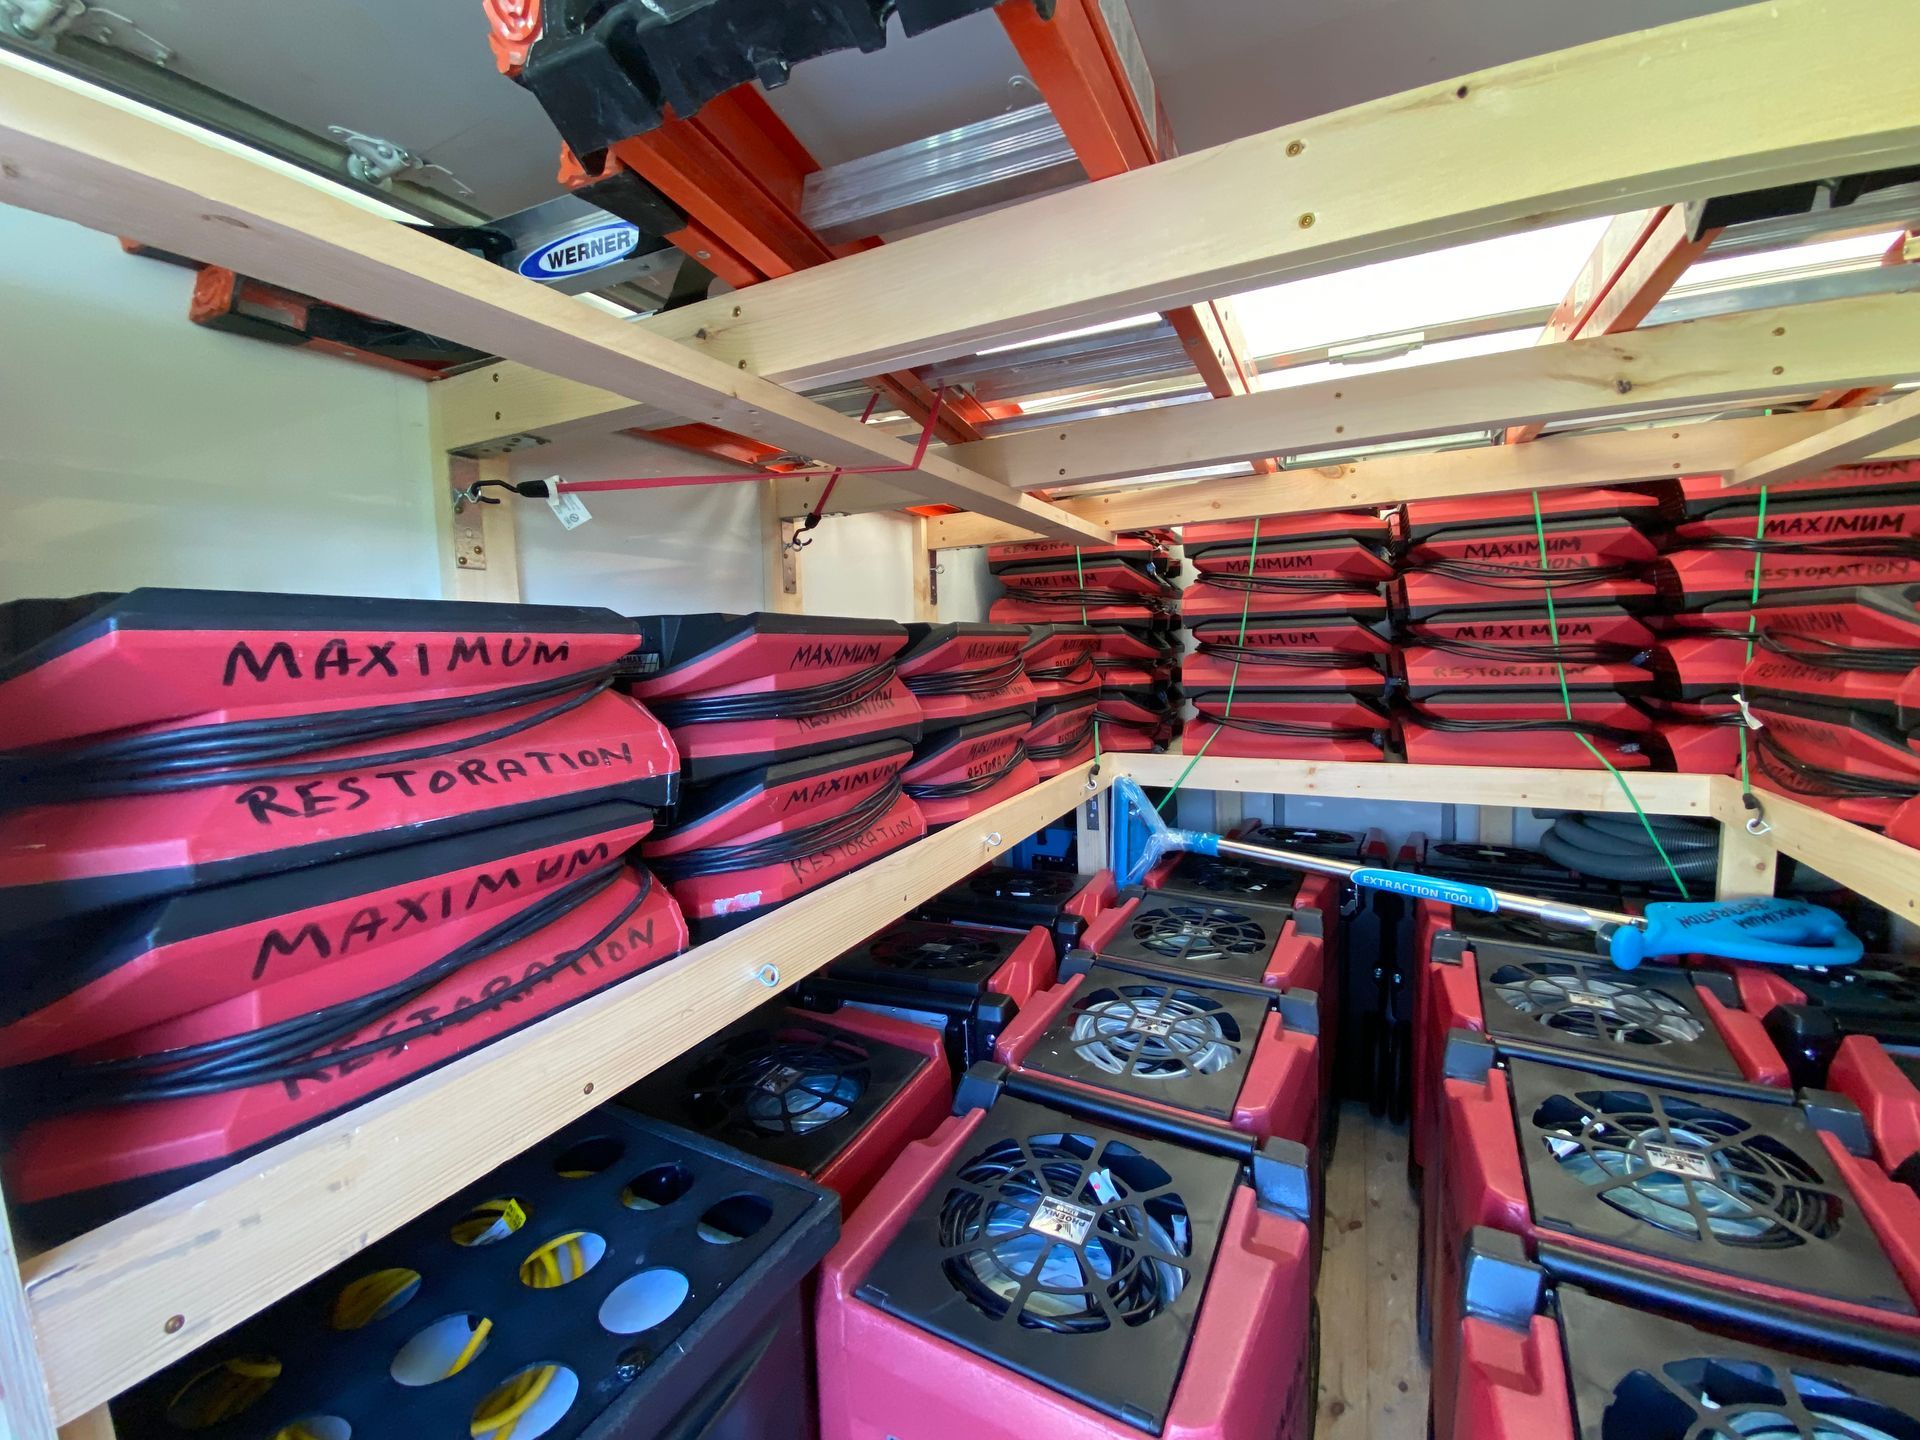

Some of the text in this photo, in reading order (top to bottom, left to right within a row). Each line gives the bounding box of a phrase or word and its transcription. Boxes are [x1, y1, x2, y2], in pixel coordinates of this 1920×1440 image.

[547, 230, 631, 269] WERNER
[1764, 512, 1905, 536] MAXIMUM
[1465, 536, 1582, 559] MAXIMUM
[1455, 622, 1593, 639] MAXIMUM
[222, 637, 571, 686] MAXIMUM
[790, 642, 881, 671] MAXIMUM
[235, 742, 632, 824] RESTORATION
[783, 761, 899, 812] MAXIMUM
[790, 816, 913, 884] RESTORATION
[1363, 875, 1475, 905] EXTRACTION TOOL
[252, 842, 609, 980] MAXIMUM
[1043, 1207, 1087, 1228] PHOENIX
